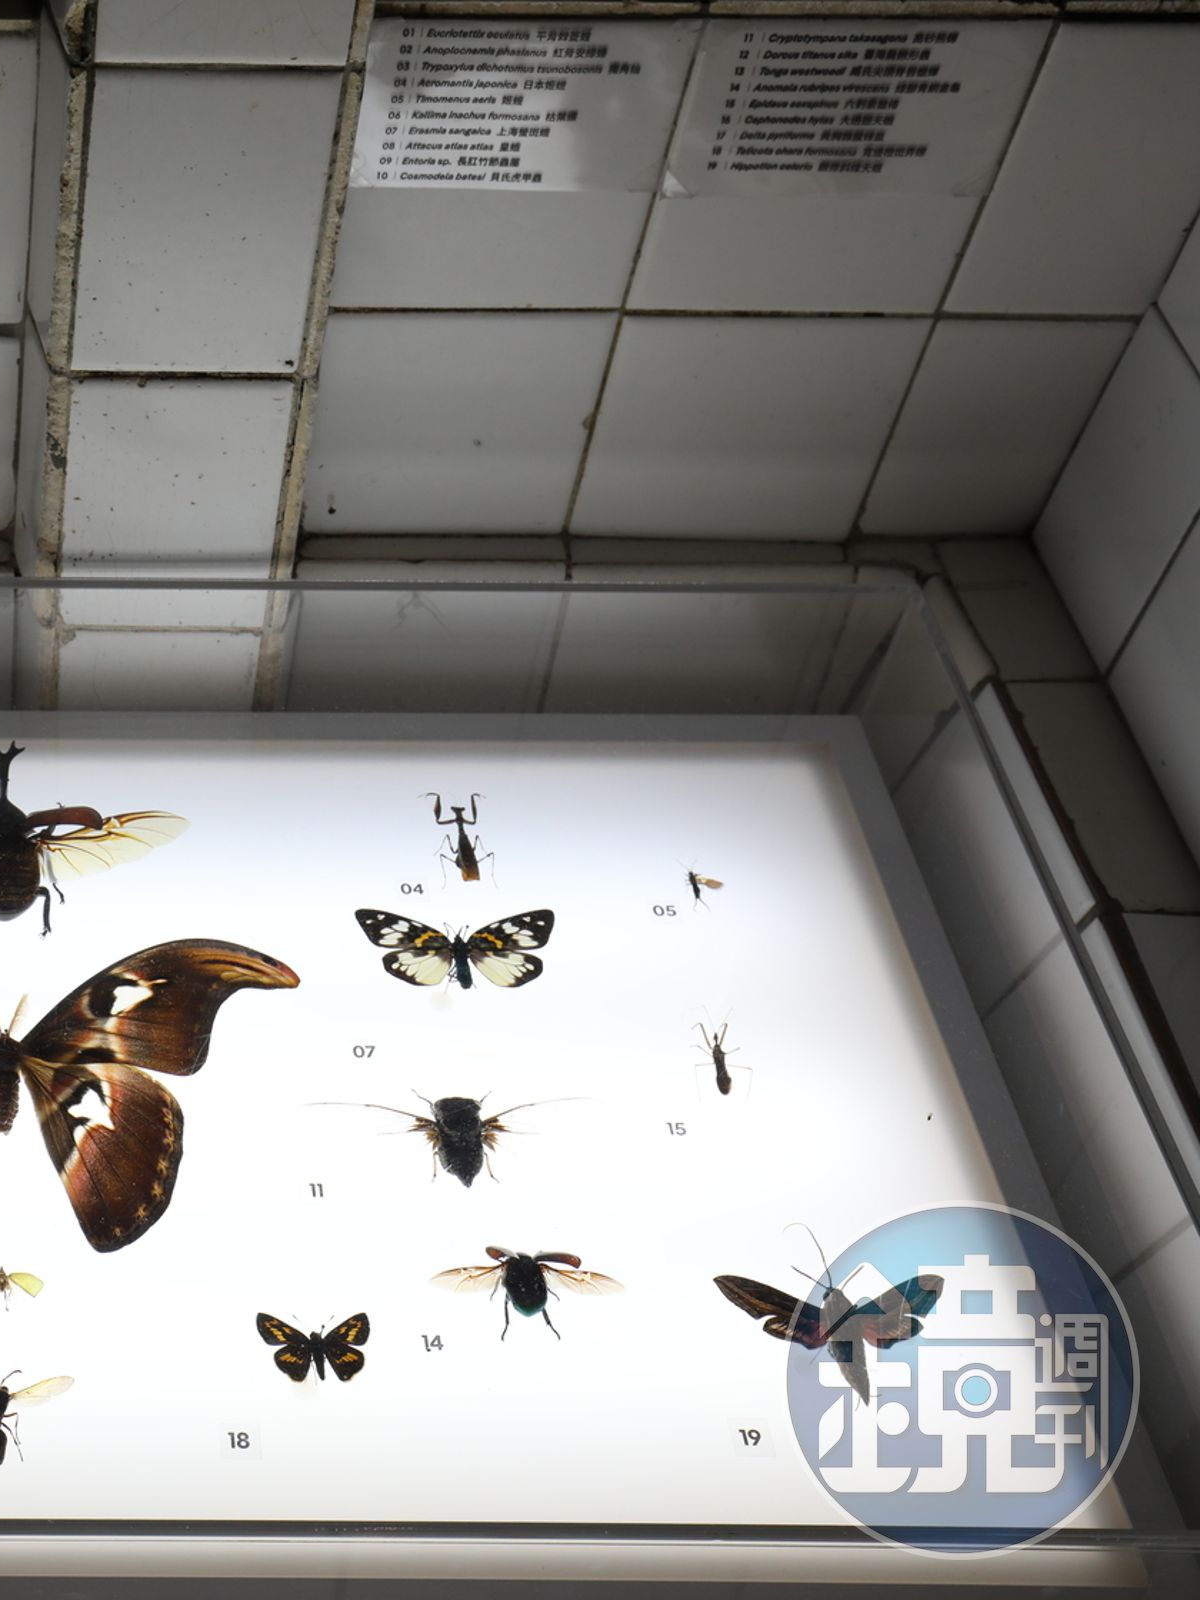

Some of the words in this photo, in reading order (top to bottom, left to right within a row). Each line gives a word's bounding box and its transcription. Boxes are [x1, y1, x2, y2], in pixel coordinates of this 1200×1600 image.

[402, 28, 415, 37] 01
[427, 28, 485, 38] Eucriotettix
[487, 30, 530, 40] oculatus
[744, 33, 753, 42] 11
[768, 33, 846, 44] Cryptotympana
[848, 33, 908, 44] takasagona
[400, 45, 413, 54] 02
[423, 45, 496, 56] Anoplocnemis
[496, 46, 547, 57] phasianus
[739, 50, 749, 59] 12
[763, 50, 800, 59] Dorcus
[801, 50, 836, 59] titanus
[837, 50, 858, 59] sika
[397, 62, 410, 71] 03
[422, 62, 475, 72] Trypoxylus
[476, 62, 534, 73] dichotomus
[608, 62, 641, 75] 獨角仙
[735, 67, 745, 76] 13
[760, 67, 788, 77] Tonga
[790, 67, 847, 76] westwoodi
[394, 78, 407, 87] 04
[417, 78, 473, 88] Acromantis
[474, 79, 518, 90] japonica
[730, 83, 740, 92] 14
[753, 83, 798, 92] Anomala
[799, 83, 840, 93] rubripes
[391, 95, 404, 103] 05
[415, 95, 470, 104] Timomenus
[472, 95, 496, 104] aeris
[725, 100, 735, 108] 15
[749, 99, 788, 109] Epidaus
[388, 111, 401, 119] 06
[411, 110, 447, 119] Kallima
[449, 110, 486, 120] inachus
[487, 111, 540, 121] formosana
[545, 110, 578, 122] 枯葉蝶
[721, 116, 730, 124] 16
[744, 115, 806, 125] Cephonodes
[808, 116, 834, 126] hylas
[385, 127, 398, 135] 07
[408, 126, 447, 135] Erasmia
[448, 127, 491, 137] sangaica
[717, 131, 726, 140] 17
[739, 131, 766, 140] Delta
[382, 142, 395, 150] 08
[405, 142, 443, 151] Attacus
[444, 142, 468, 151] atlas
[469, 143, 494, 151] atlas
[712, 147, 722, 155] 18
[736, 147, 774, 156] Telicota
[775, 147, 803, 156] ohara
[804, 147, 857, 156] formosana
[379, 157, 392, 165] 09
[402, 157, 436, 166] Entoria
[437, 158, 452, 168] sp.
[707, 162, 717, 171] 19
[730, 162, 779, 172] Hippotion
[779, 162, 813, 172] celerio
[376, 172, 388, 180] 10
[400, 172, 454, 181] Cosmodela
[455, 172, 486, 181] batesi
[400, 883, 424, 895] 04
[653, 904, 677, 917] 05
[352, 1045, 376, 1059] 07
[666, 1123, 687, 1137] 15
[309, 1184, 323, 1198] 11
[421, 1335, 444, 1350] 14
[227, 1431, 250, 1449] 18
[738, 1428, 762, 1447] 19
